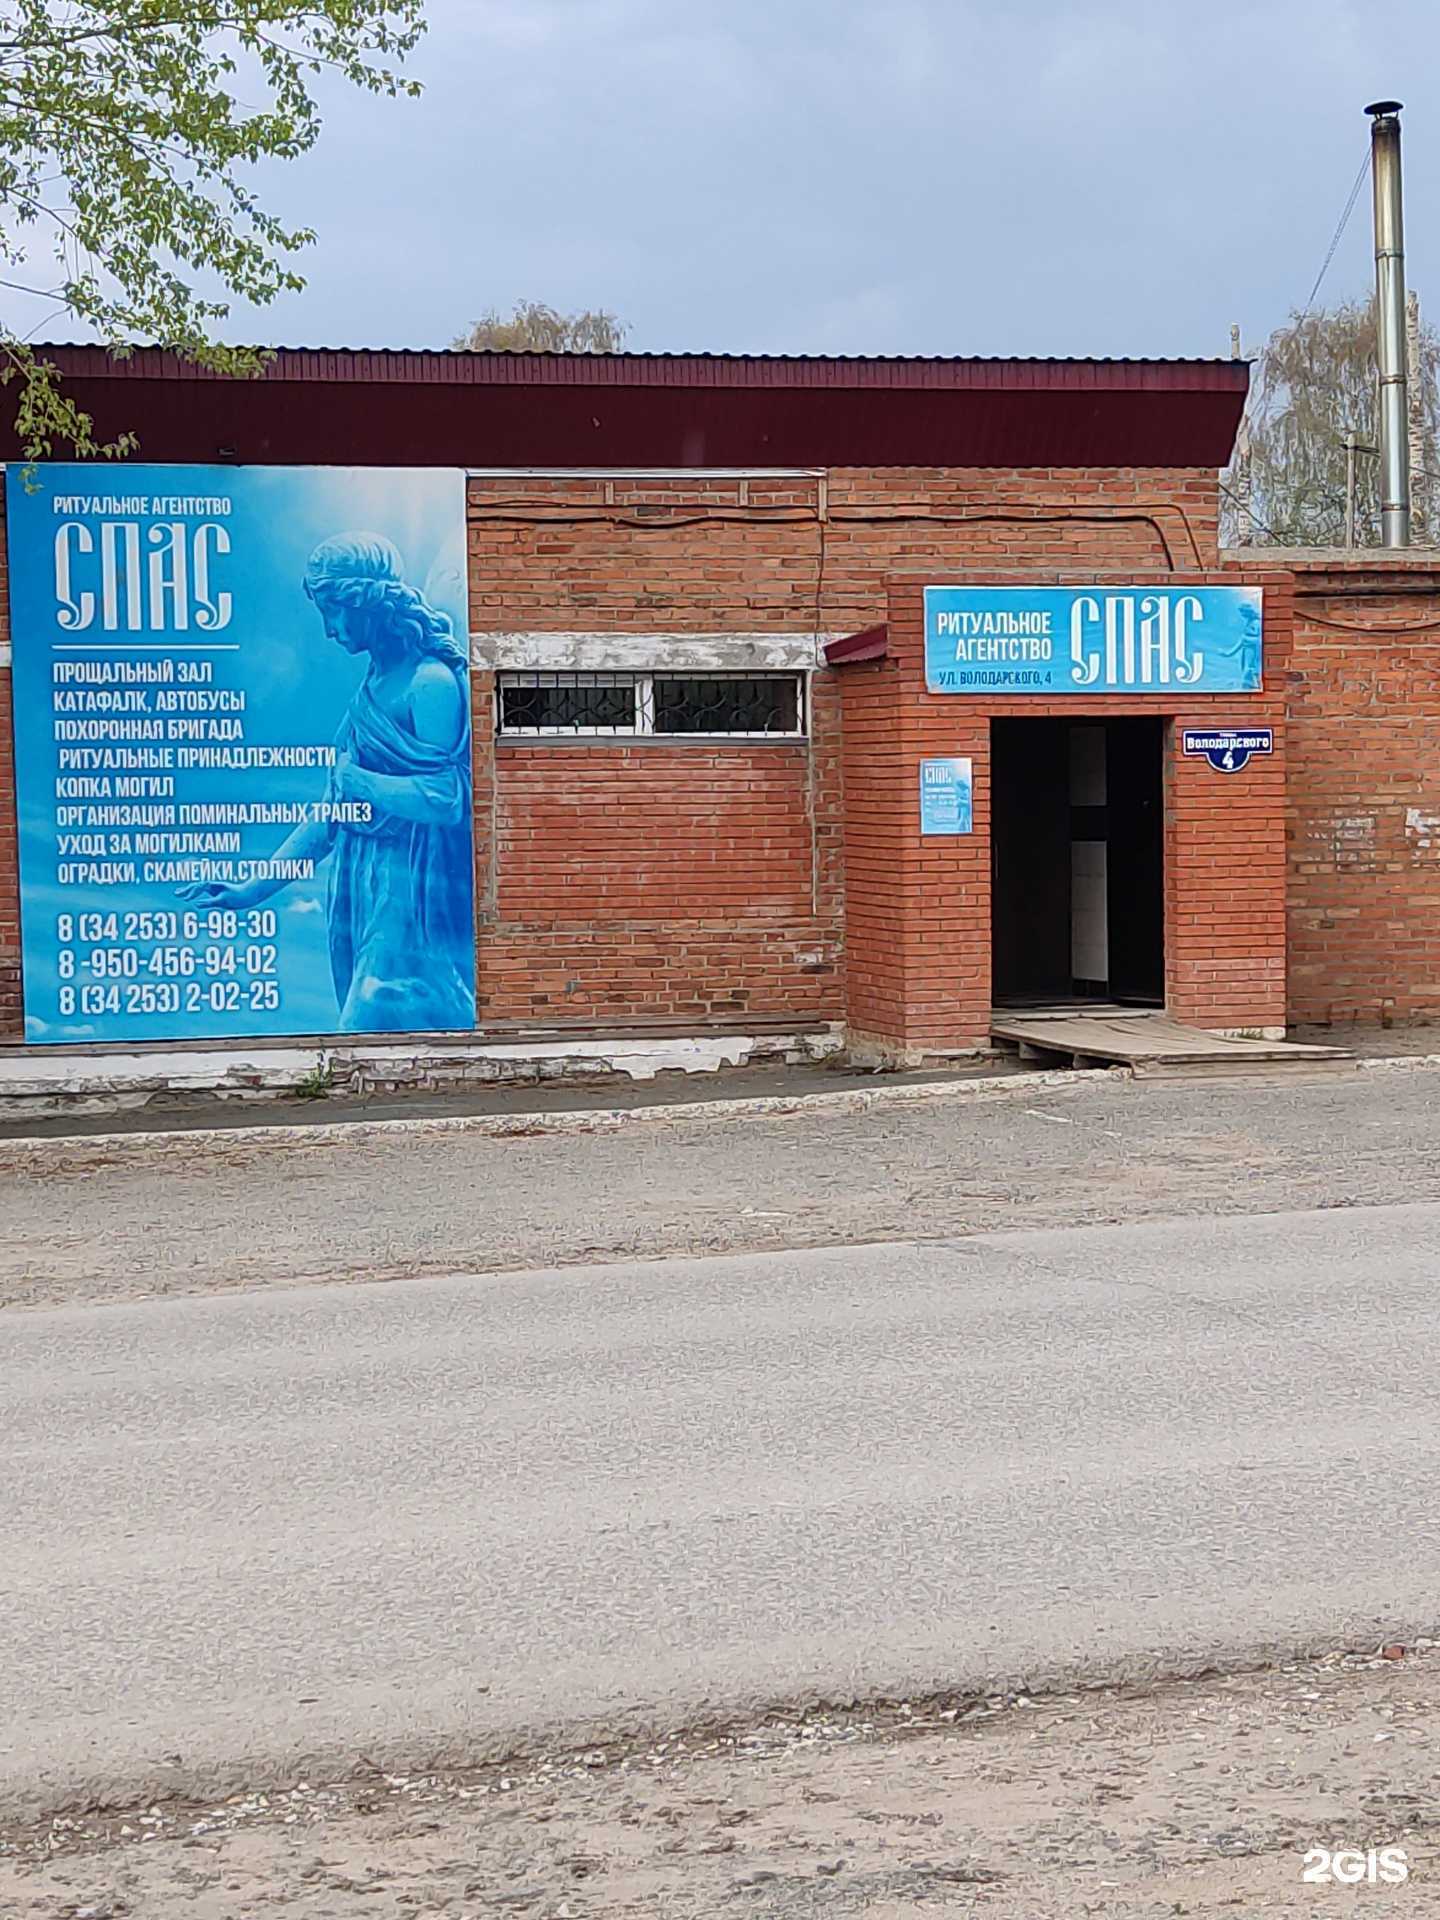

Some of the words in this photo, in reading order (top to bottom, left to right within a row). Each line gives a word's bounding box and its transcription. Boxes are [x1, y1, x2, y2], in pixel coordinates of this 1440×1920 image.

[53, 496, 149, 515] РИТУАЛЬНОЕ
[152, 495, 232, 515] АГЕНТСТВО
[53, 522, 233, 631] СПАС
[937, 611, 1052, 635] РИТУАЛЬНОЕ
[956, 637, 1052, 661] АГЕНТСТВО
[1070, 596, 1204, 685] СПАС
[53, 661, 174, 683] ПРОЩАЛЬНЫЙ
[178, 663, 212, 682] ЗАЛ
[1044, 671, 1052, 685] 4
[53, 691, 152, 713] КАТАФАЛК,
[156, 690, 245, 712] АВТОБУСЫ
[54, 719, 164, 741] ПОХОРОННАЯ
[168, 718, 243, 741] БРИГАДА
[1186, 735, 1270, 751] Володарского
[59, 747, 174, 769] РИТУАЛЬНЫЕ
[177, 746, 337, 768] ПРИНАДЛЕЖНОСТИ
[1222, 751, 1234, 769] 4
[56, 777, 111, 798] КОПКА
[115, 776, 174, 798] МОГИЛ
[56, 805, 175, 827] ОРГАНИЗАЦИЯ
[179, 803, 308, 824] ПОМИНАЛЬНЫХ
[313, 802, 372, 822] ТРАПЕЗ
[57, 834, 106, 856] УХОД
[110, 833, 131, 854] ЗА
[135, 831, 240, 854] МОГИЛКАМИ
[58, 861, 140, 885] ОГРАДКИ,
[58, 915, 73, 942] 8
[79, 913, 118, 942] (34
[124, 912, 177, 941] 253)
[183, 909, 276, 939] 6-98-30
[60, 987, 74, 1015] 8
[82, 985, 121, 1014] (34
[127, 983, 180, 1013] 253)
[186, 981, 279, 1011] 2-02-25
